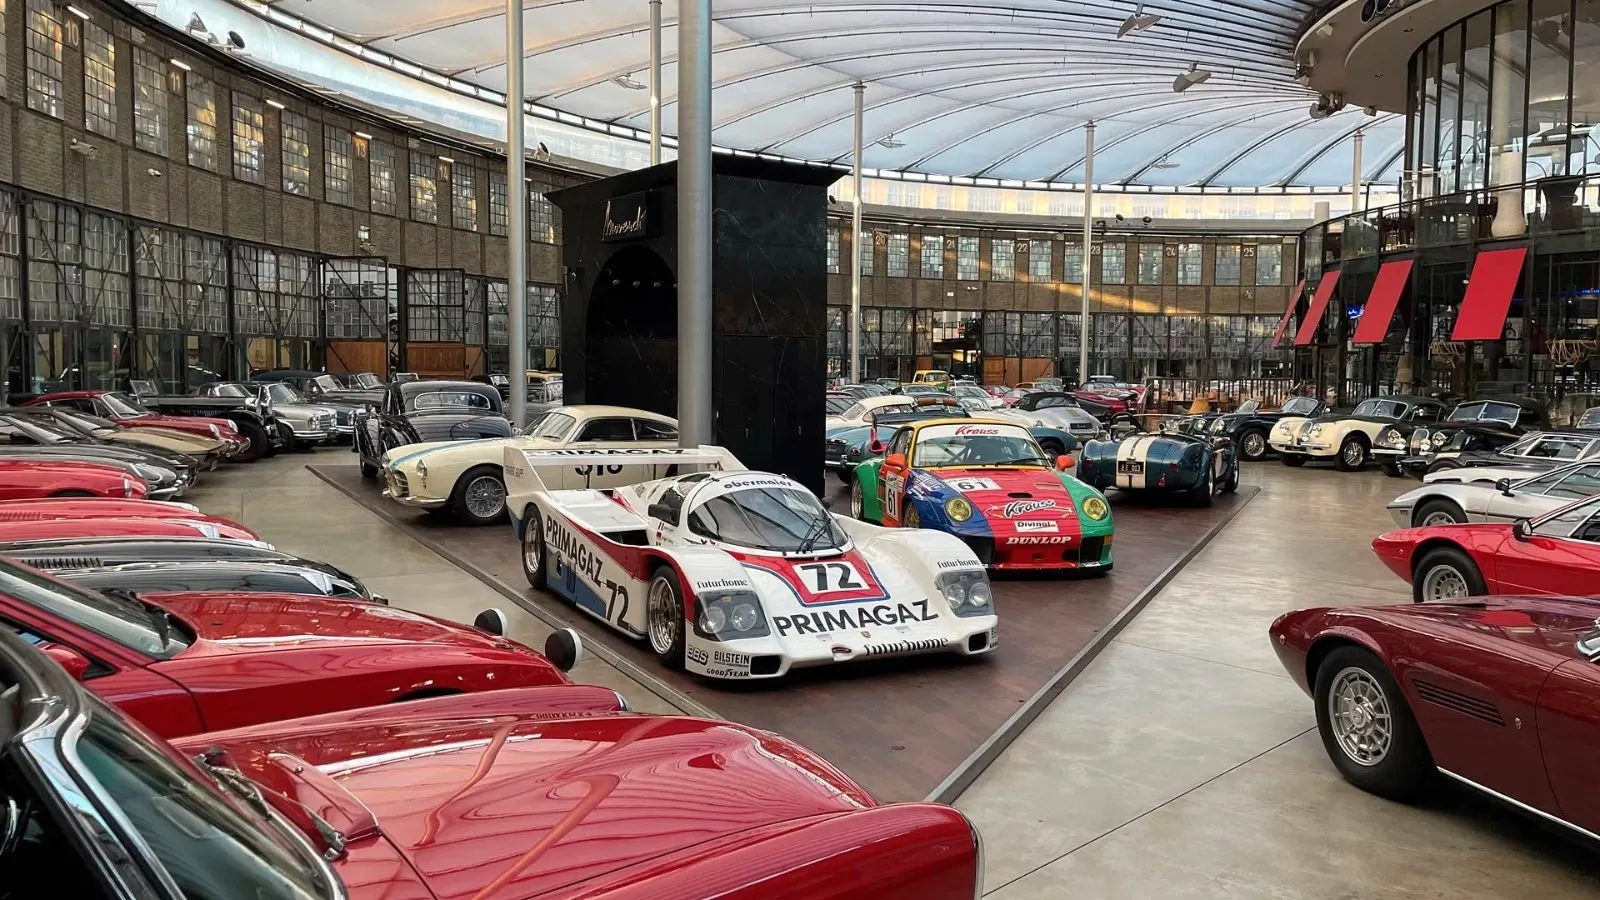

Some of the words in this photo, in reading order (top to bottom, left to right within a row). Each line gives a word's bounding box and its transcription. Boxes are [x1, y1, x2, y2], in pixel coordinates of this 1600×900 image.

[65, 20, 80, 46] 10
[170, 71, 180, 92] 11
[355, 142, 366, 158] 13
[439, 164, 449, 181] 14
[875, 235, 886, 246] 20
[946, 239, 956, 249] 21
[1017, 243, 1028, 253] 22
[1091, 245, 1101, 255] 23
[1165, 246, 1176, 257] 24
[1243, 247, 1255, 257] 25
[955, 425, 1000, 436] Krauss
[723, 479, 792, 489] obermaier
[957, 481, 989, 490] 61
[887, 488, 896, 516] 61
[1005, 500, 1055, 518] Krauss
[1006, 536, 1072, 545] DUNLOP
[545, 515, 603, 588] PRIMAGAZ
[936, 558, 981, 569] futurhome
[696, 578, 749, 589] futurhome
[801, 563, 862, 591] 72
[606, 579, 629, 631] 72
[772, 599, 939, 637] PRIMAGAZ
[863, 636, 949, 657] futurhome
[687, 645, 709, 666] BBS
[714, 651, 750, 665] BILSTEIN
